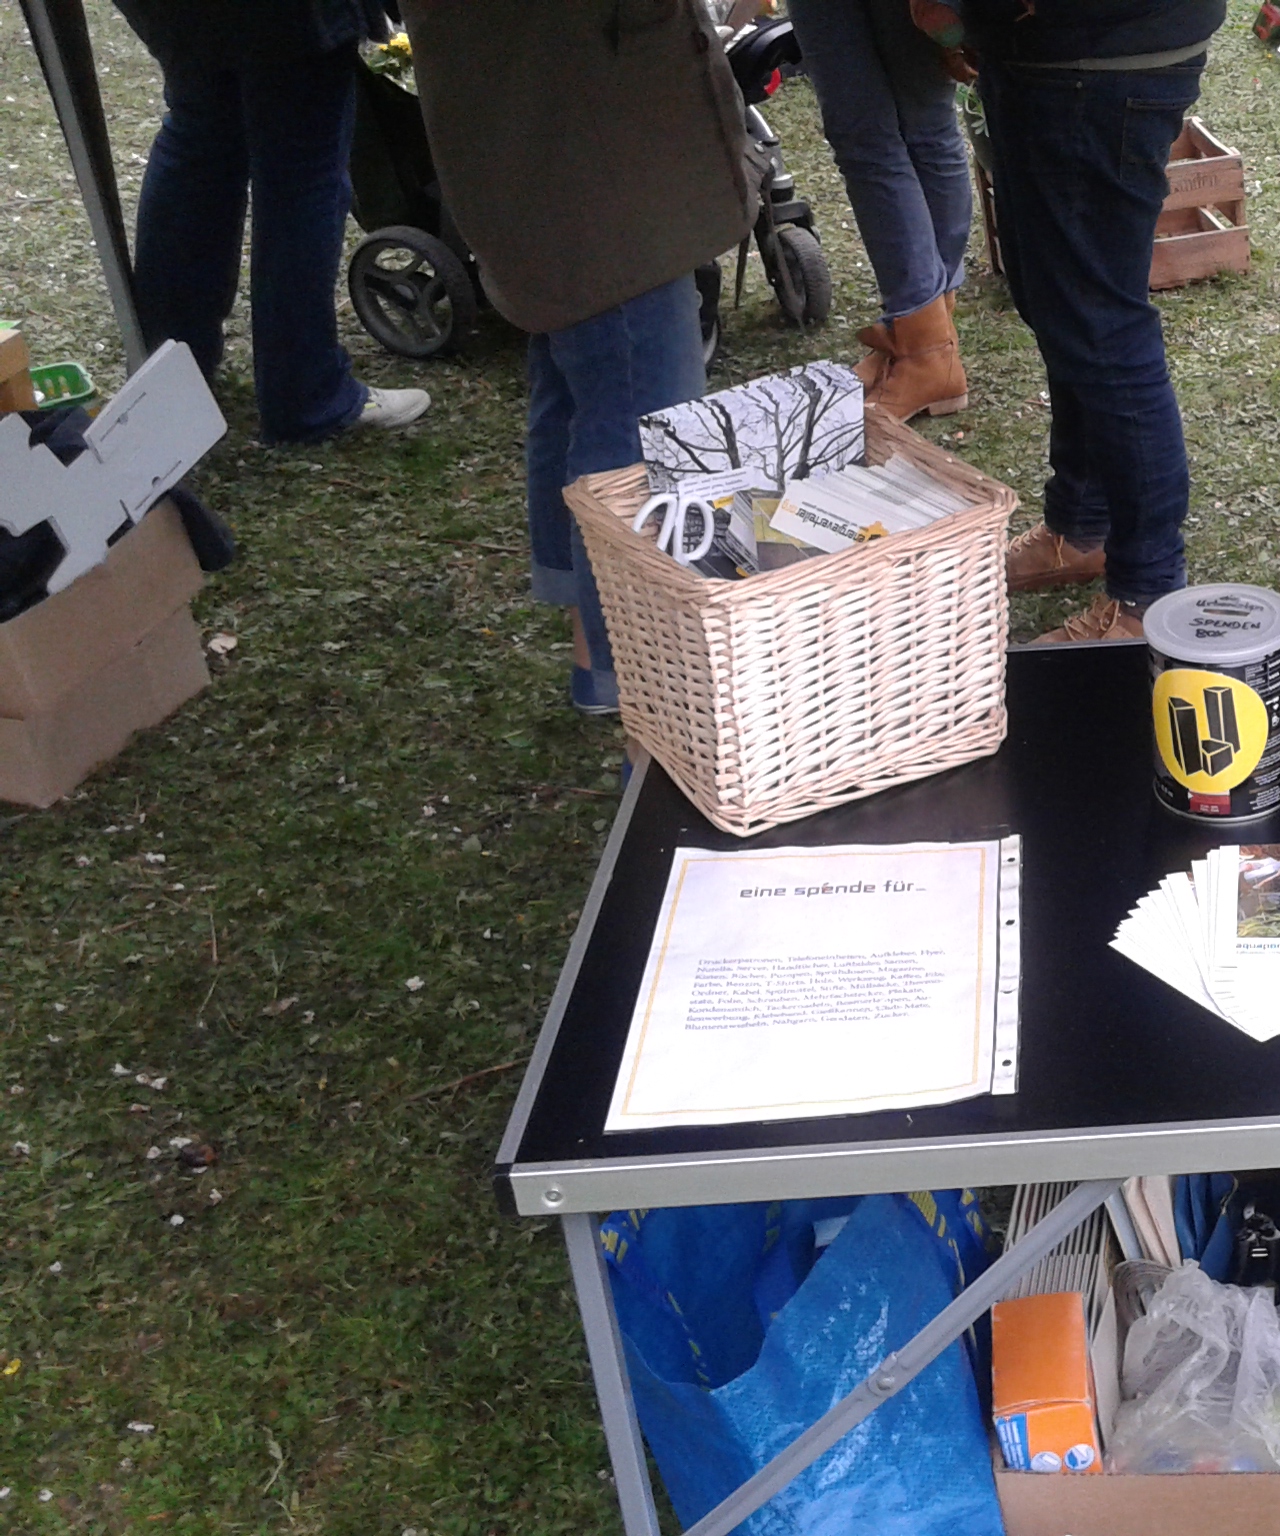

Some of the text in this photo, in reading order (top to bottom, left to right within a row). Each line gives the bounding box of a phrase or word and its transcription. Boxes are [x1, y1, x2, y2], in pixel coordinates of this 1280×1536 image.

[1189, 617, 1261, 630] SPENDEN
[1195, 628, 1228, 638] BOX
[739, 886, 787, 898] eine
